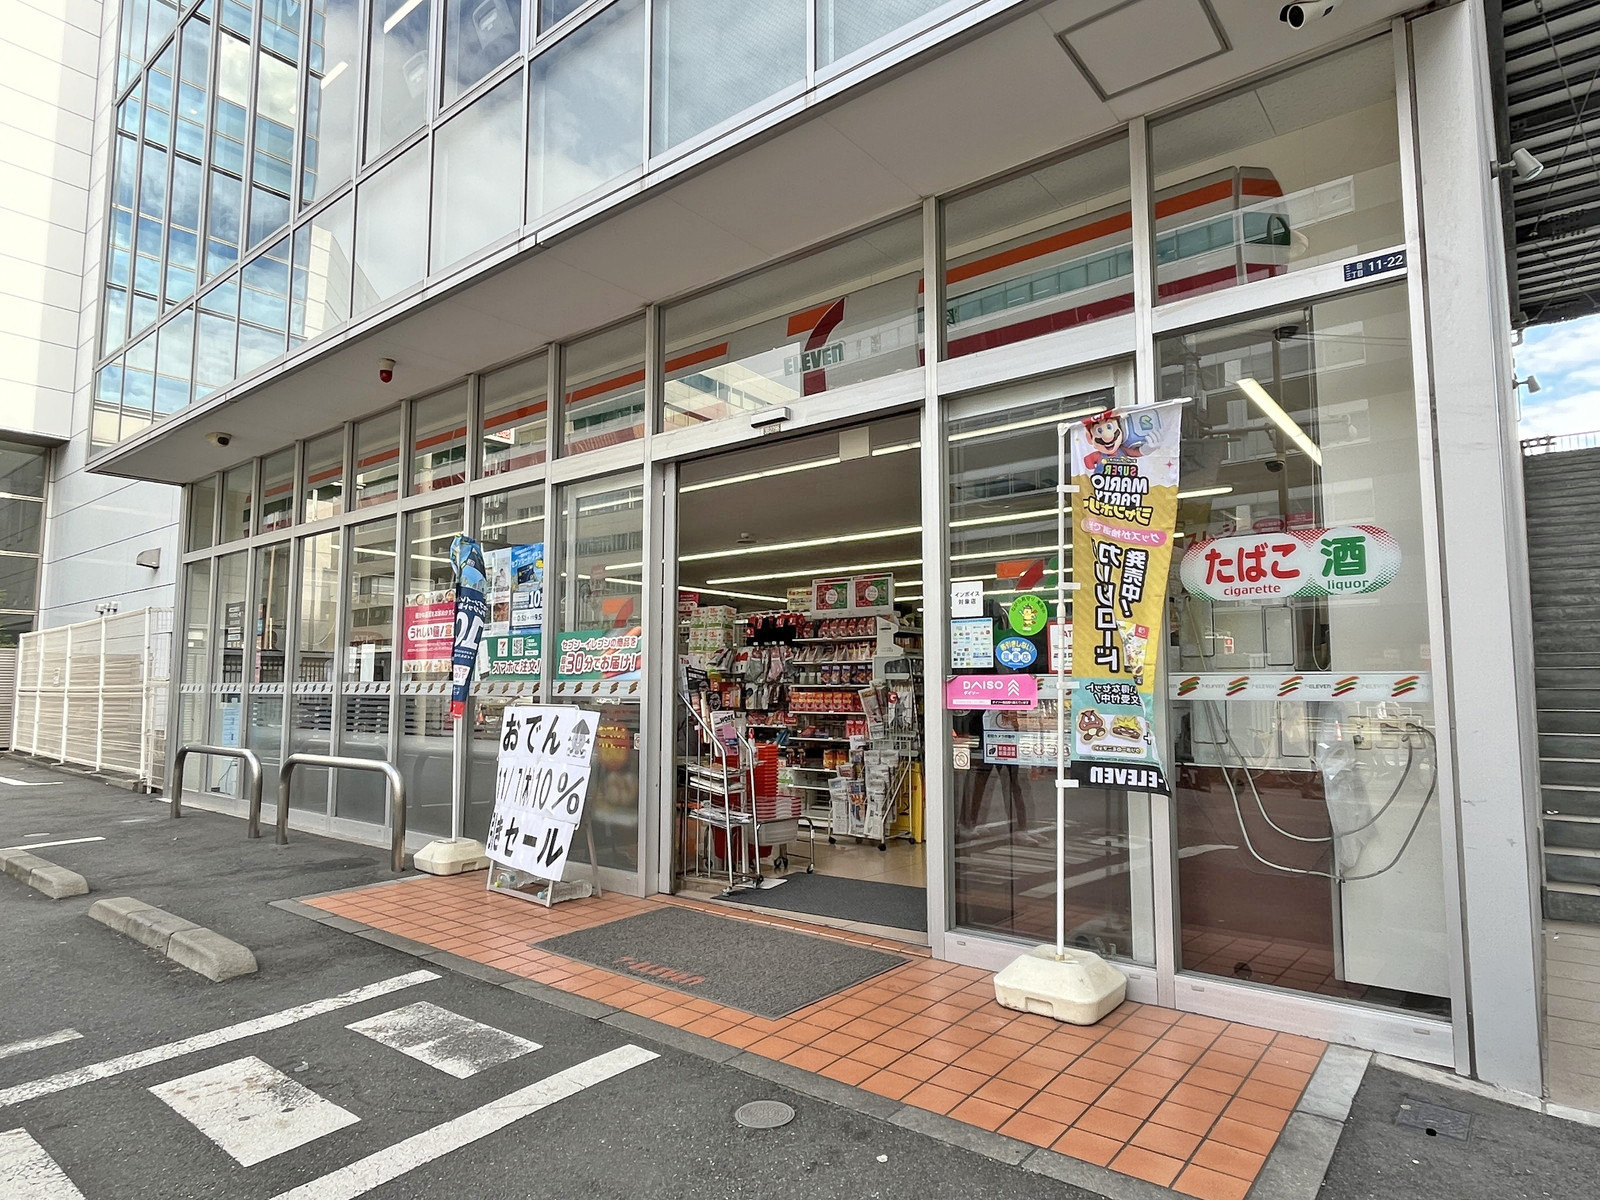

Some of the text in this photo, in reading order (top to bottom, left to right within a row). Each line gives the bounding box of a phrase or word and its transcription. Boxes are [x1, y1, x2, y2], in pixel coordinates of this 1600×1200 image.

[1368, 254, 1404, 272] 11-22
[1205, 535, 1367, 584] たばこ 酒
[1223, 579, 1370, 597] cigarette liquor
[963, 680, 1003, 690] DAISO
[502, 713, 561, 756] おでん
